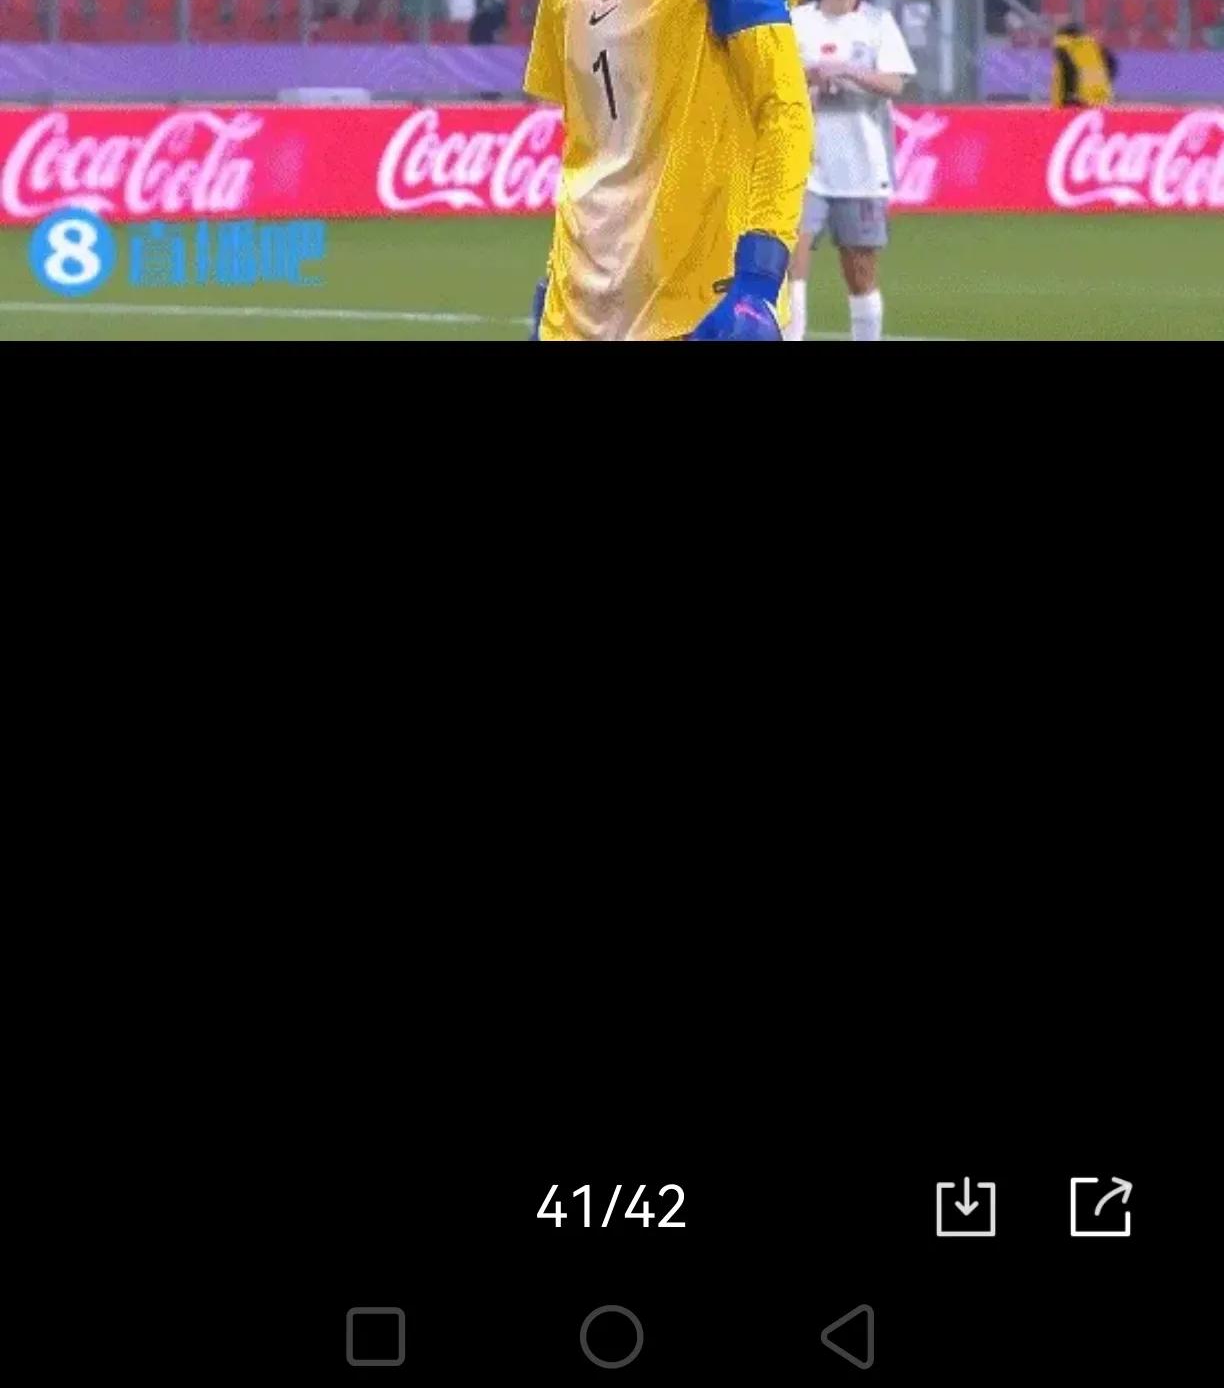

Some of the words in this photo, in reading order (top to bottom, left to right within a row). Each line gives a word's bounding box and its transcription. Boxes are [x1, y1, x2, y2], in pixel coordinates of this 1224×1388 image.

[592, 49, 618, 120] 1
[377, 108, 565, 210] Coca-Co
[1046, 109, 1224, 207] Coca-Co
[536, 1183, 686, 1228] 41/42
